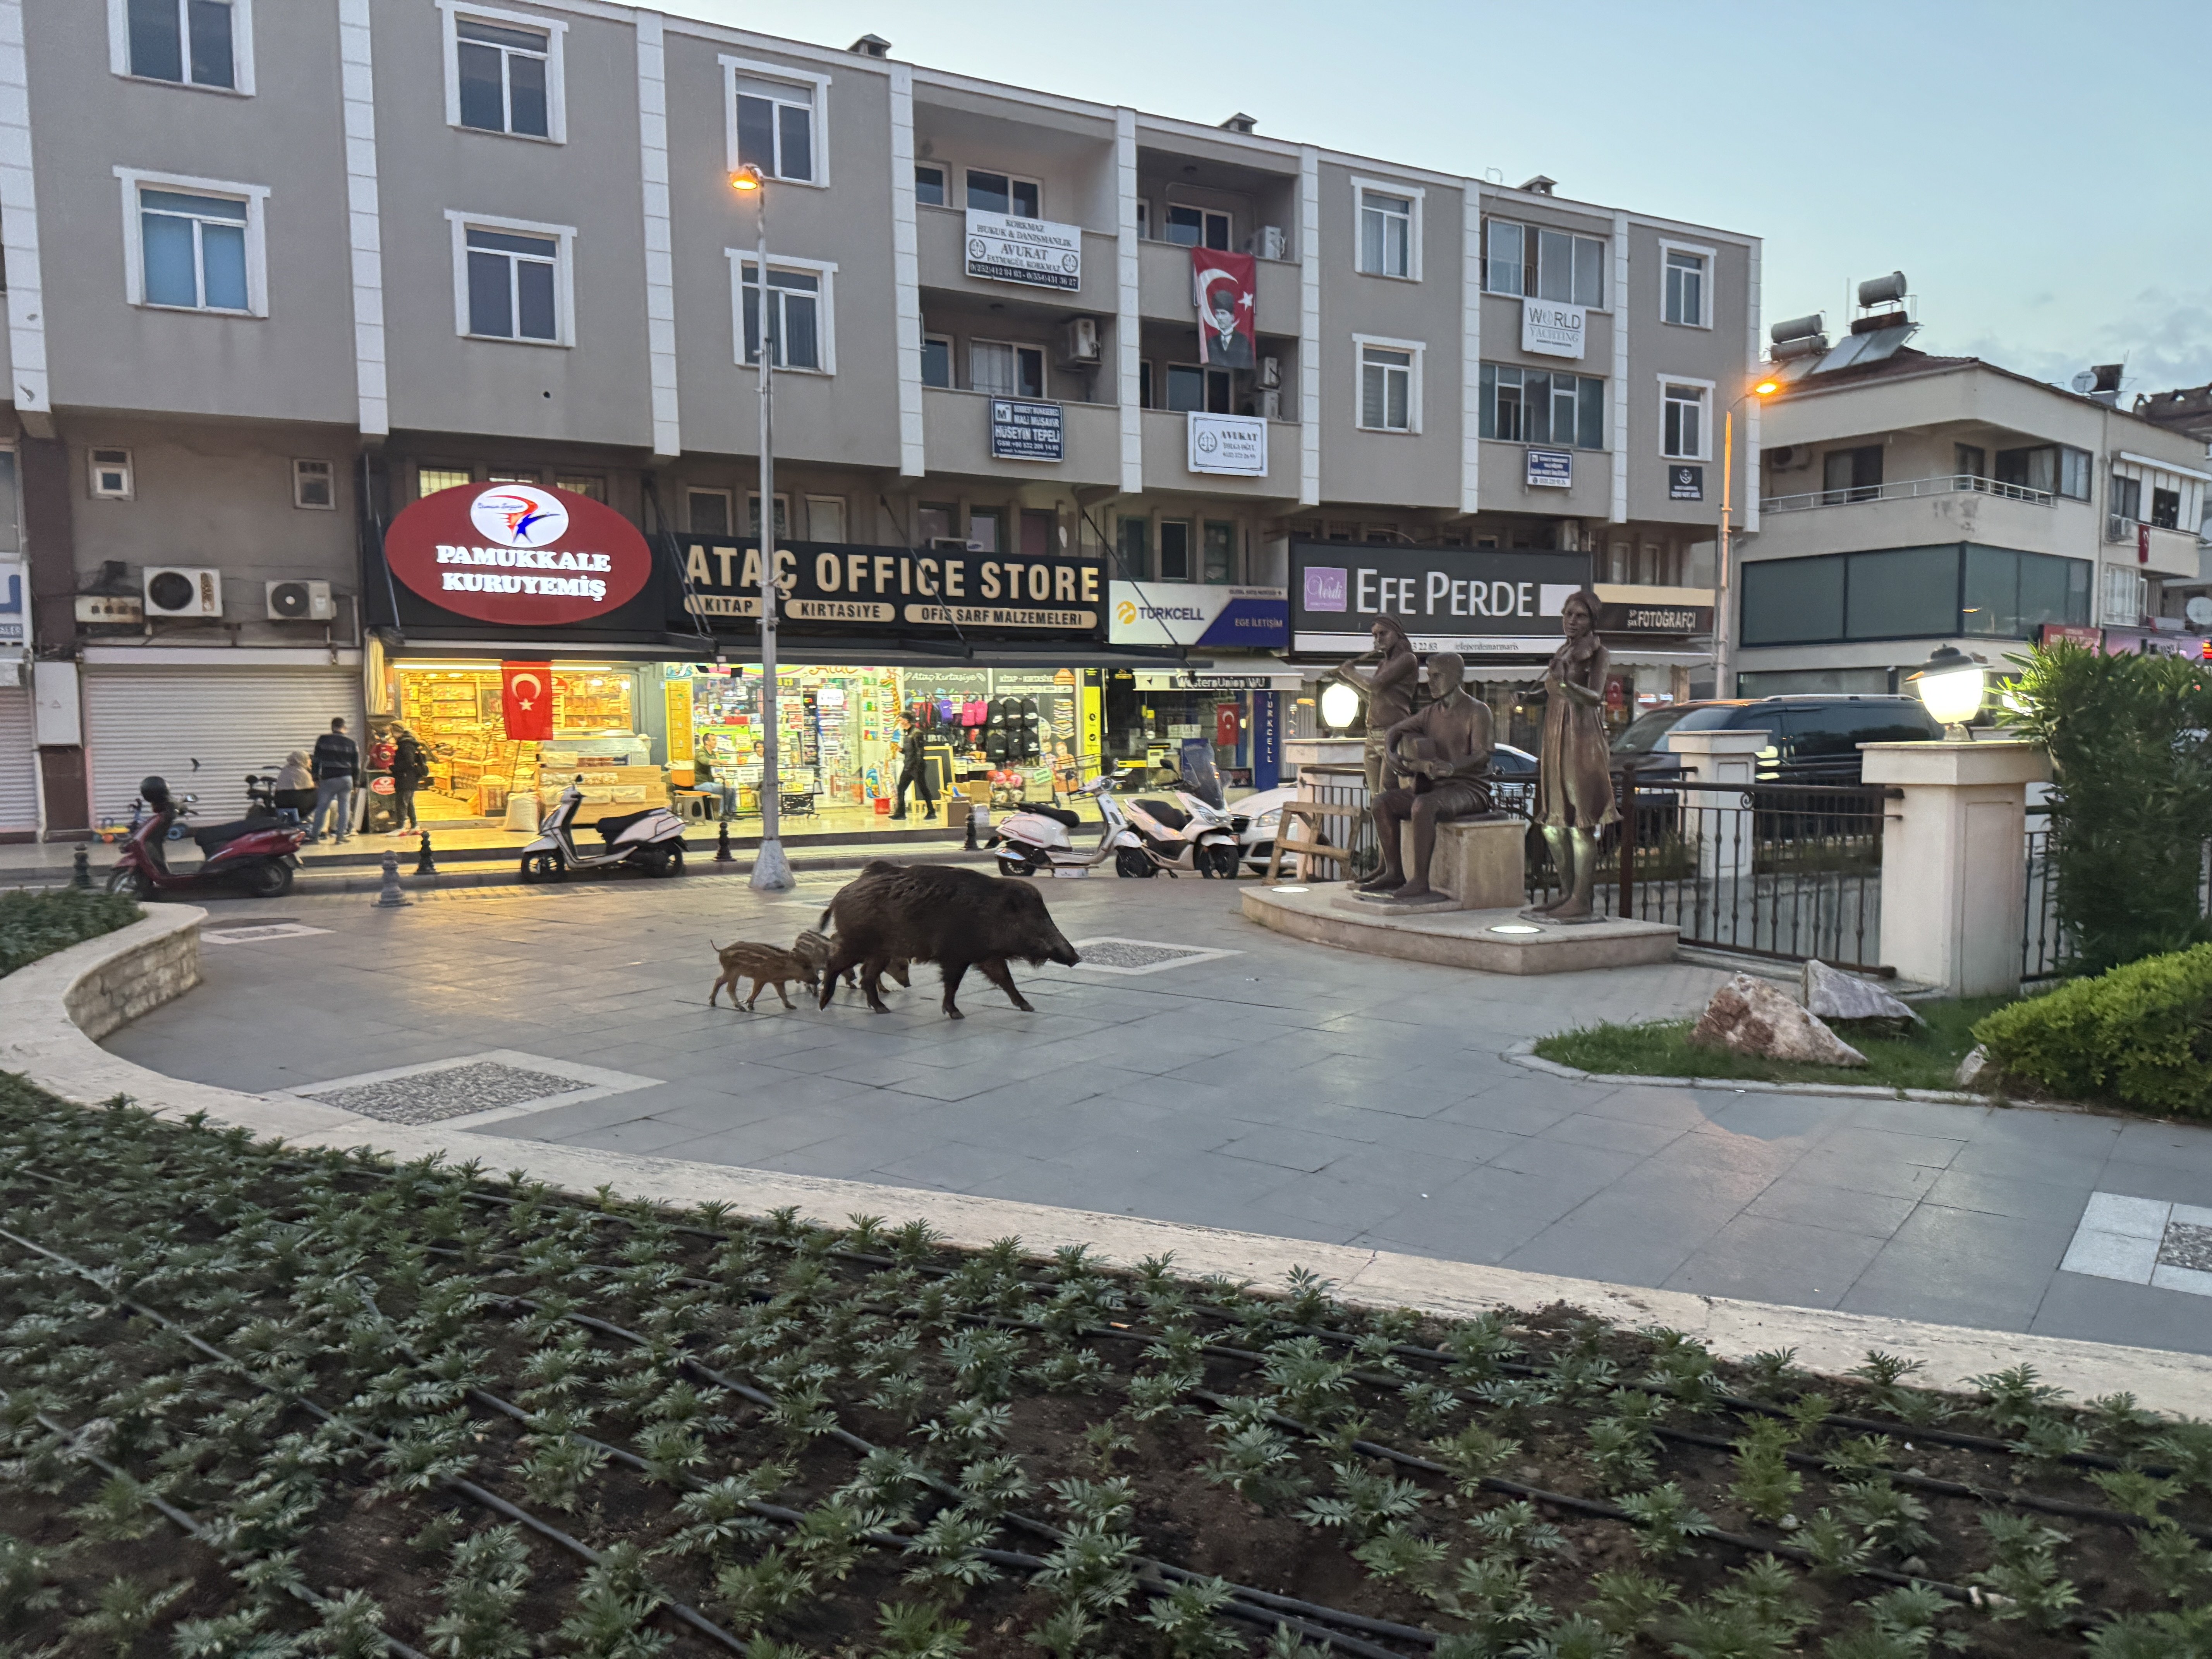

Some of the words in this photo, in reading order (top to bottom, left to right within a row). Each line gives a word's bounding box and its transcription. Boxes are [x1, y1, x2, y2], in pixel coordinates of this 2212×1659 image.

[1001, 244, 1049, 261] AVUKAT
[1529, 307, 1580, 329] WORLD
[435, 545, 611, 572] PAMUKKALE
[684, 544, 797, 600] ATAÇ
[816, 552, 965, 597] OFFICE
[981, 562, 1099, 602] STORE
[442, 573, 607, 602] KURUYEMİŞ
[957, 609, 990, 622] SARF
